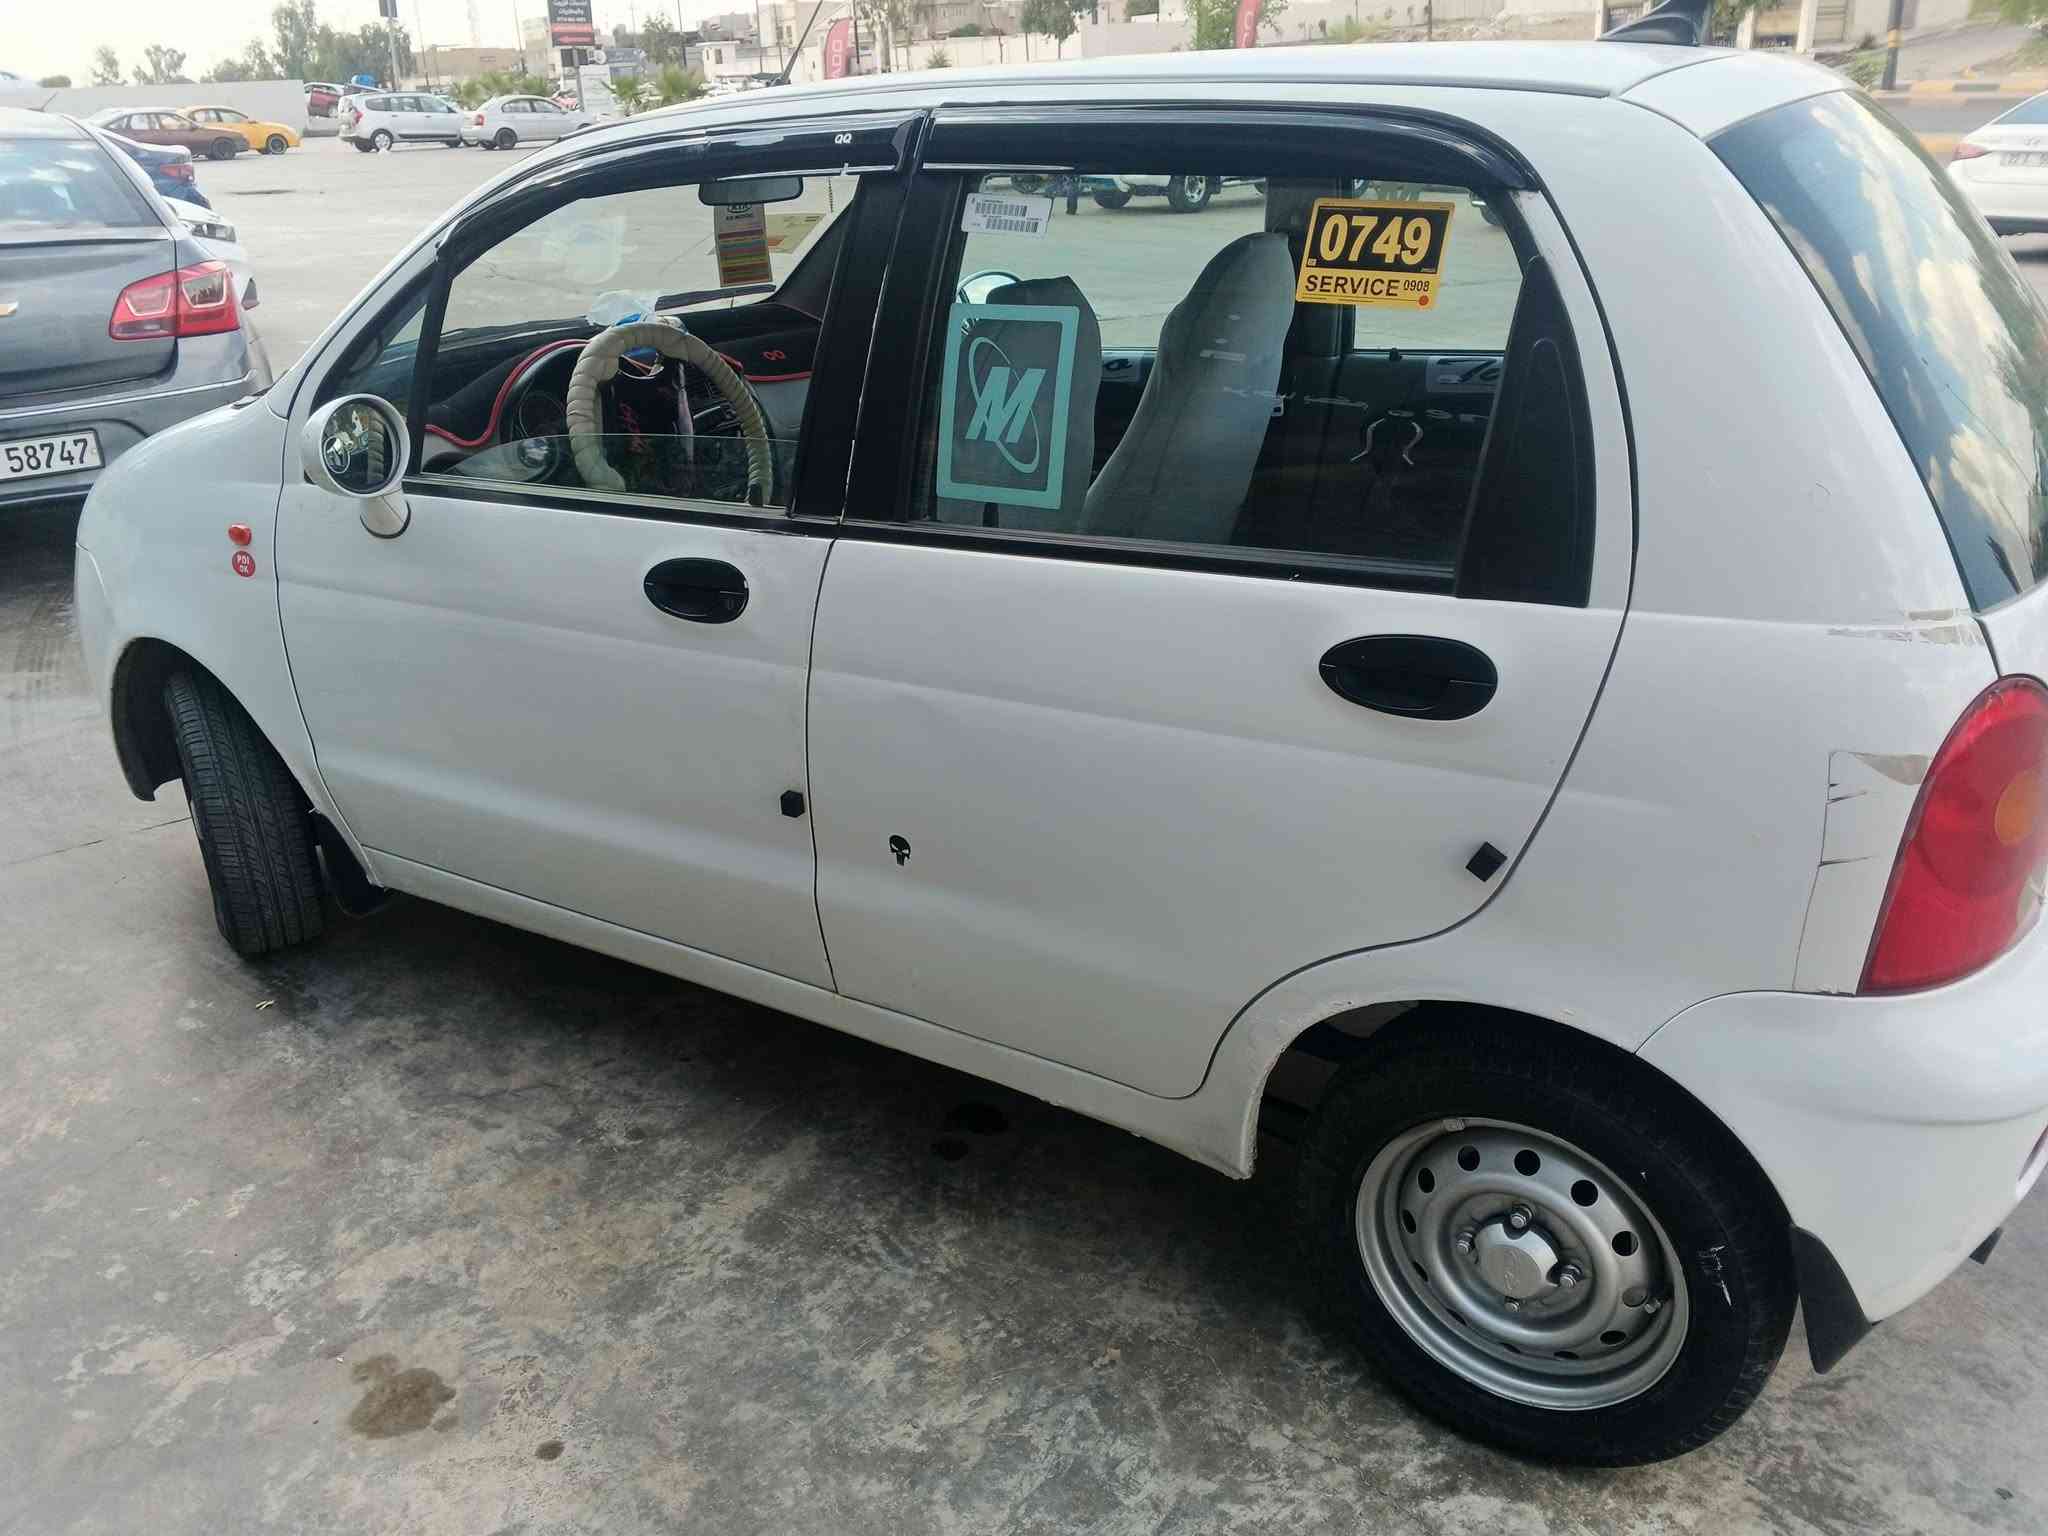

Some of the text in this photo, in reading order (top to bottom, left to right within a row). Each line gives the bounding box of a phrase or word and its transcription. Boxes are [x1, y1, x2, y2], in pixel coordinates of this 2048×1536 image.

[1320, 214, 1431, 265] 0749
[1305, 275, 1400, 297] SERVICE
[4, 438, 88, 473] 58747
